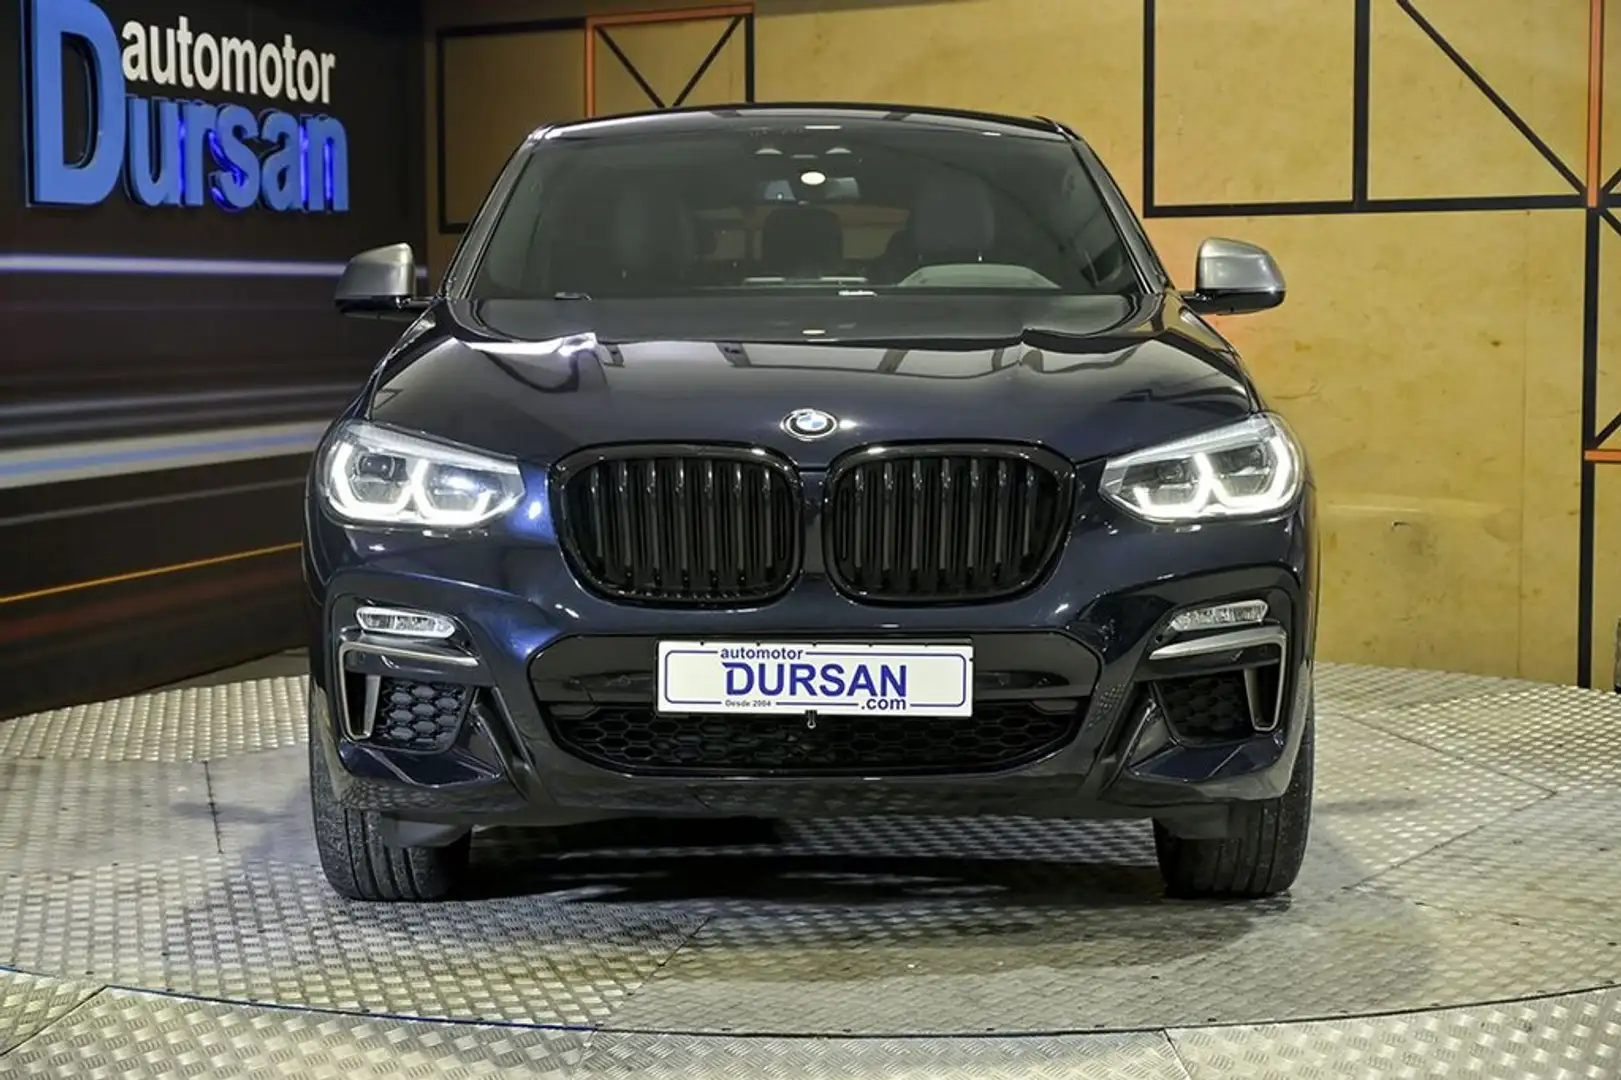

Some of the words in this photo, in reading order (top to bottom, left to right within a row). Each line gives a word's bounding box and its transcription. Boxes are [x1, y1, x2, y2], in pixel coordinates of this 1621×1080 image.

[121, 15, 336, 104] automotor
[24, 0, 349, 211] Dursan
[720, 647, 804, 660] automotor
[722, 662, 906, 697] DURSAN
[725, 699, 750, 707] Desde
[861, 697, 907, 710] .com
